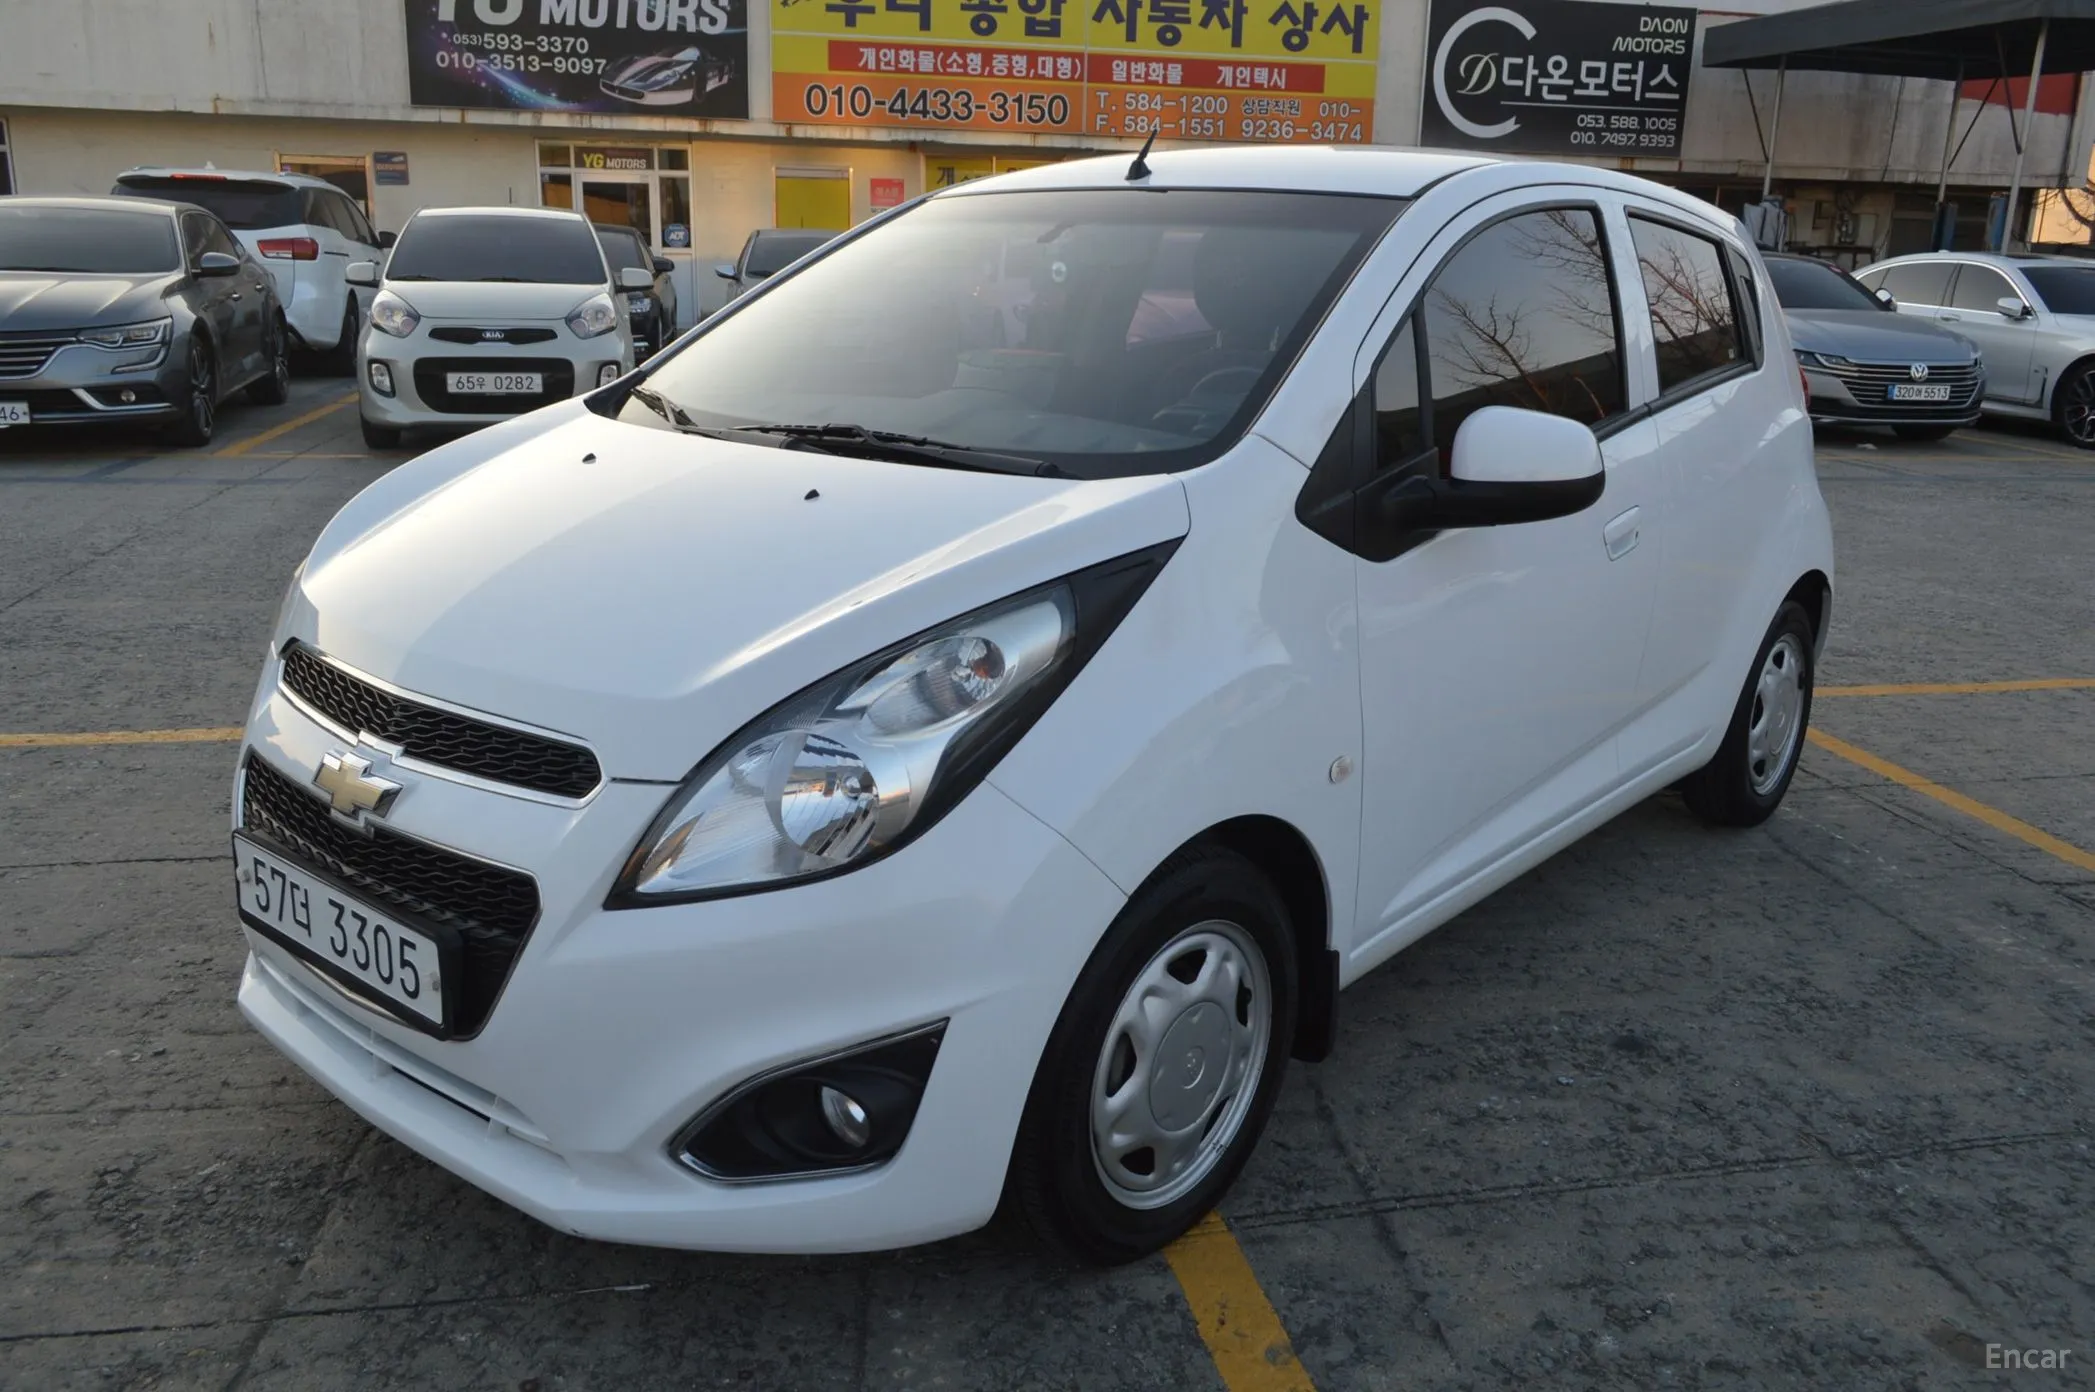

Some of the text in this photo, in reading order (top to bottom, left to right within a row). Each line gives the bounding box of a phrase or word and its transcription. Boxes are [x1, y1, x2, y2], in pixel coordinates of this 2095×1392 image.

[1268, 0, 1370, 54] 상사
[453, 33, 590, 54] 053)593-3370
[1612, 36, 1686, 55] MOTORS
[436, 51, 607, 75] 010-3513-9097
[1111, 60, 1287, 89] 일반화물 개인택시
[1502, 54, 1680, 101] 다온모터스
[804, 83, 1070, 125] 010-4433-3150
[1124, 92, 1229, 115] 584-1200
[1123, 115, 1226, 138] 584-1551
[1241, 119, 1363, 143] 9236-3474
[583, 153, 646, 169] YG MOTORS
[494, 376, 534, 391] 0282
[253, 857, 421, 1000] 57더 3305
